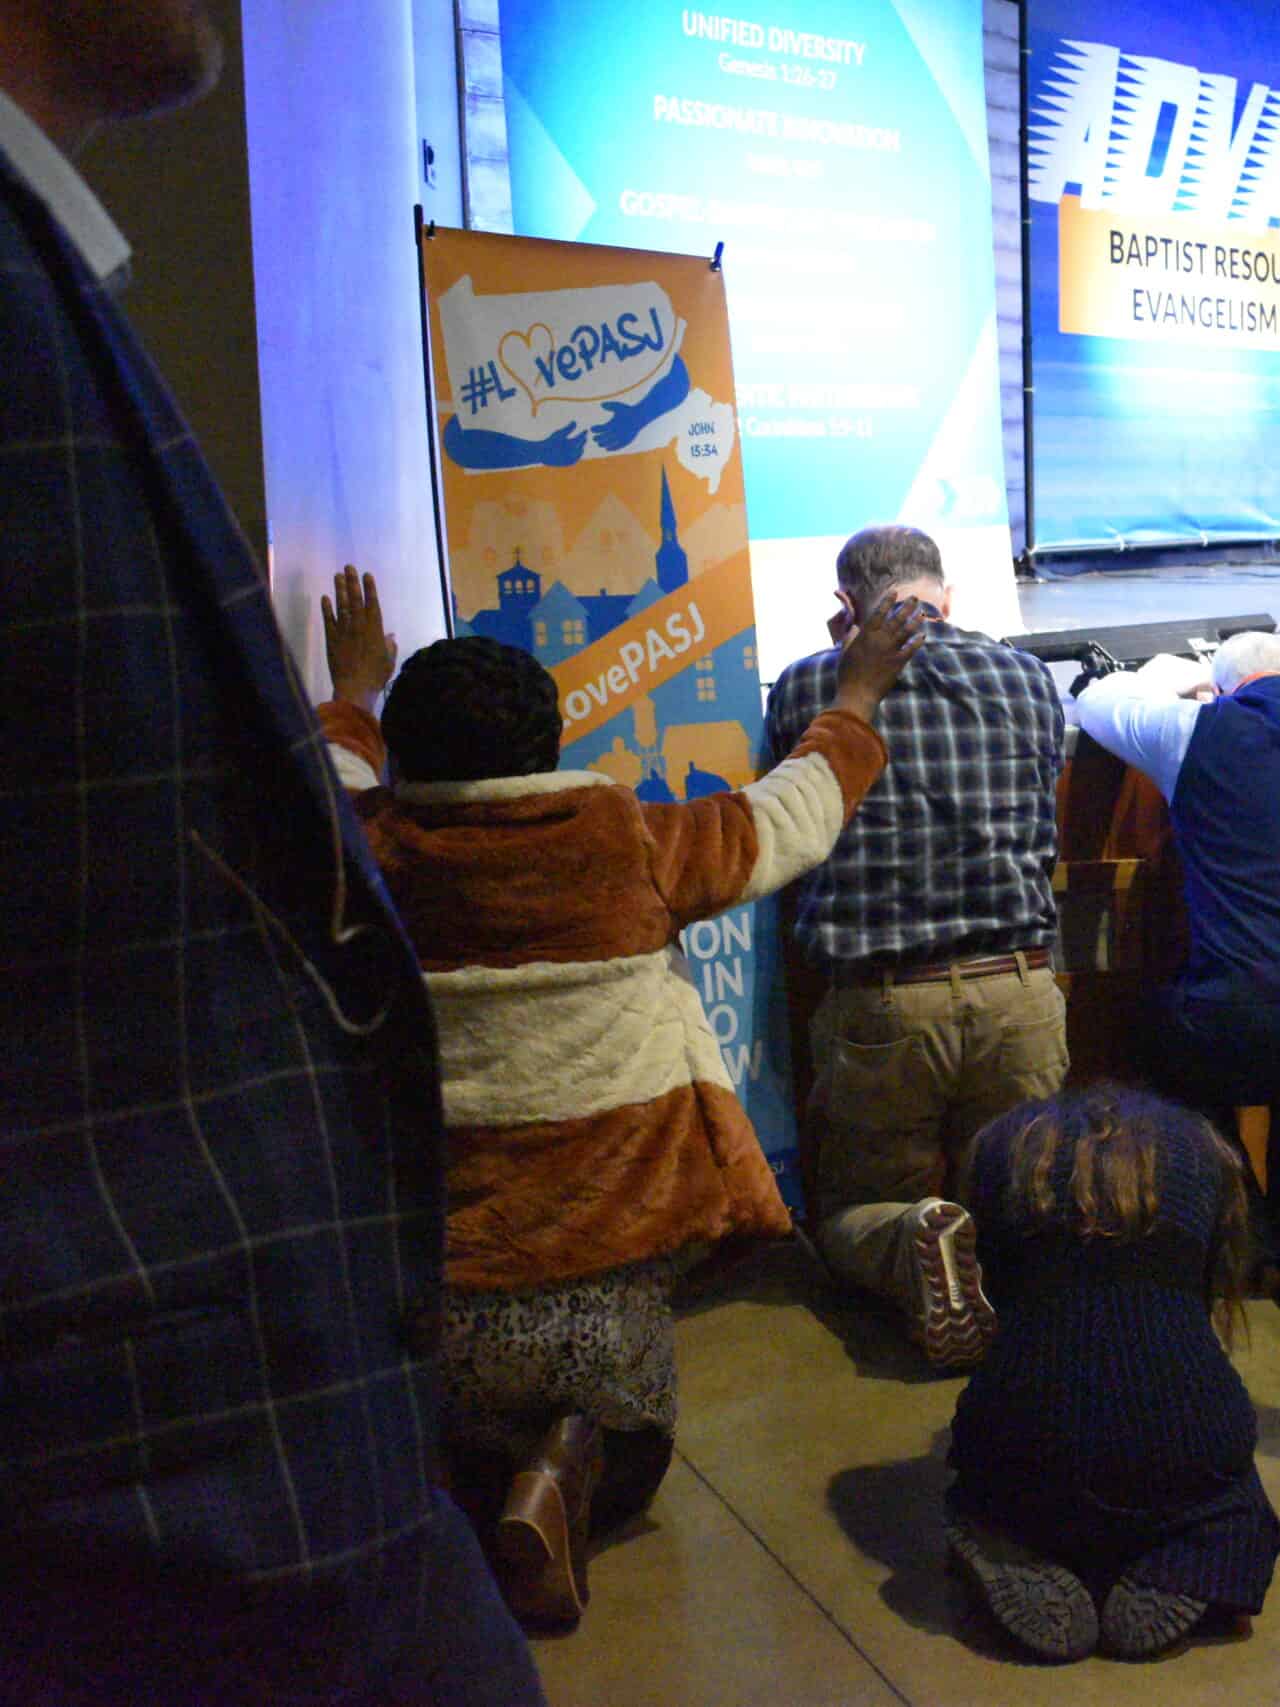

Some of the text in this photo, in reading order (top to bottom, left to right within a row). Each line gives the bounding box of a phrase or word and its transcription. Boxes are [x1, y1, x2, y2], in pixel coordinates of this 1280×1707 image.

[681, 9, 866, 66] UNIFIED DIVERSITY
[653, 94, 779, 137] PASSIONATE
[1109, 230, 1208, 275] BAPTIST
[1132, 288, 1278, 336] EVANGELISM
[687, 421, 716, 436] JOHN
[562, 601, 706, 729] ovePASJ
